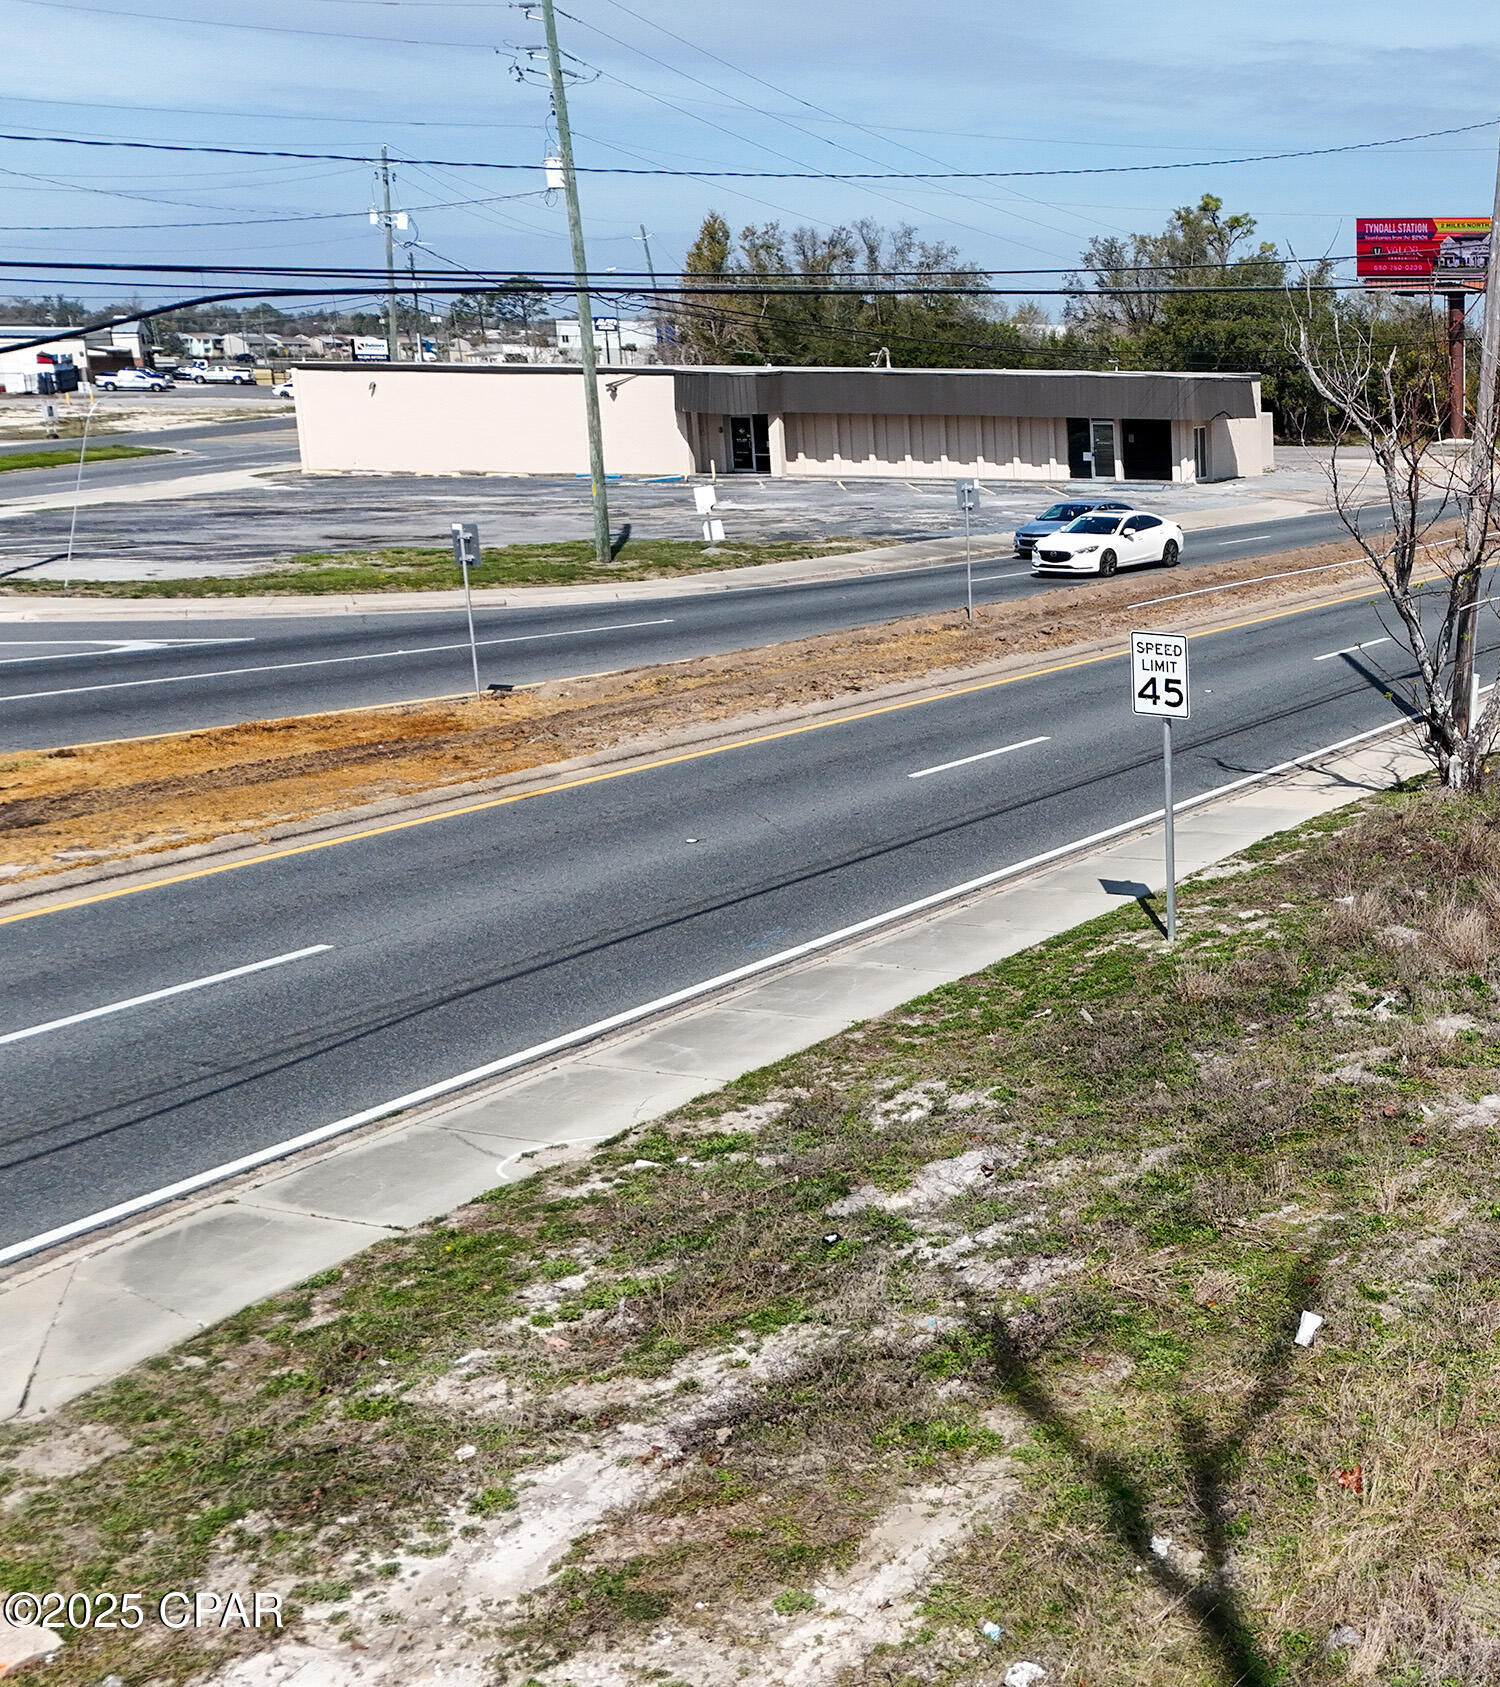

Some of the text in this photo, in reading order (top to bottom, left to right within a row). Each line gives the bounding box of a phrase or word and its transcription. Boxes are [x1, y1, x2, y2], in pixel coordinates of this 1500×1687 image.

[1364, 223, 1428, 233] TYNDALL STATION
[1136, 641, 1183, 657] SPEED
[1141, 658, 1178, 674] LIMIT
[1137, 676, 1184, 708] 45
